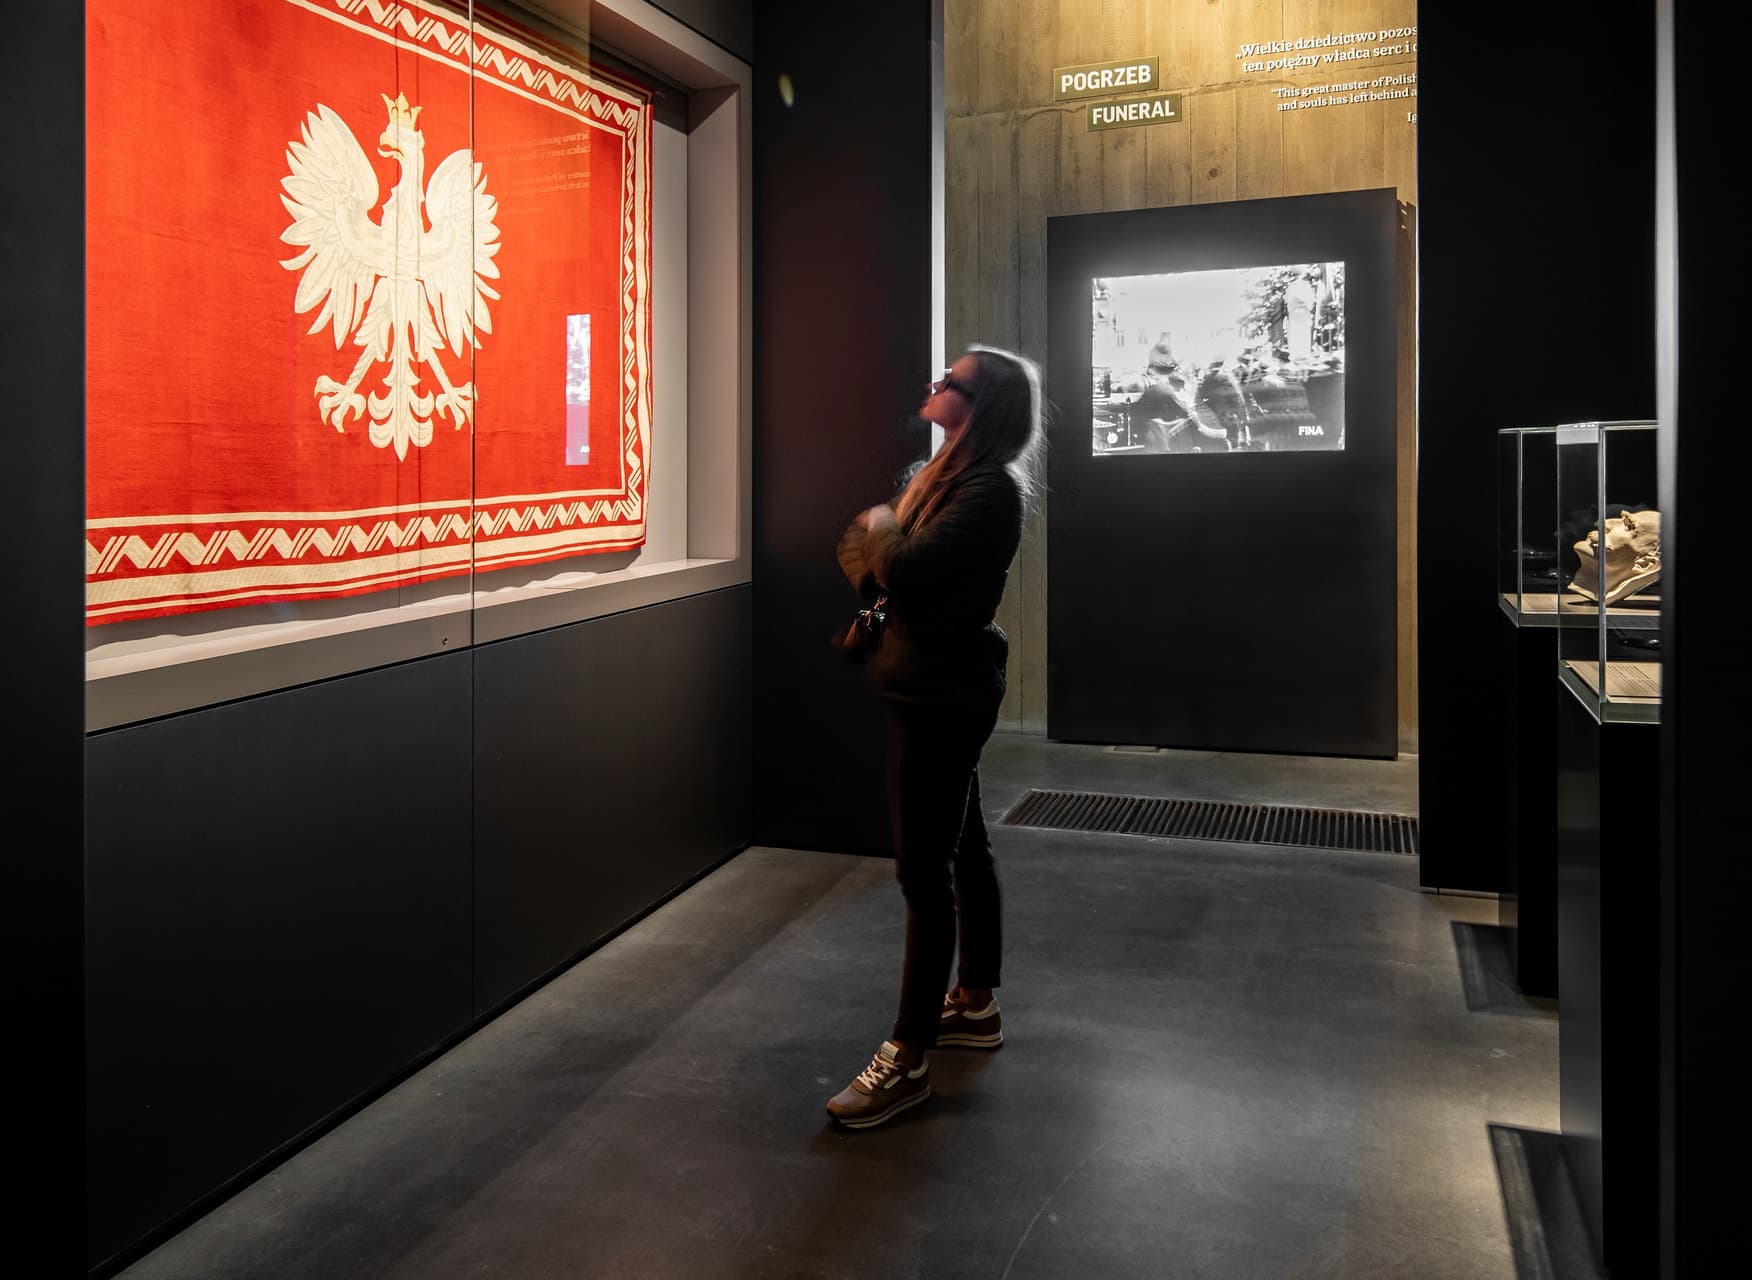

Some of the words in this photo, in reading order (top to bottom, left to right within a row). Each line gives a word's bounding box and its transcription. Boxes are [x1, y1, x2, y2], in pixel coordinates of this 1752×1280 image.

[1235, 40, 1293, 59] „Wielkie
[1295, 31, 1377, 50] dziedzictwo
[1242, 61, 1264, 73] ten
[1267, 54, 1321, 73] potężny
[1323, 47, 1371, 63] władca
[1373, 44, 1402, 57] serc
[1405, 41, 1411, 53] i
[1061, 64, 1152, 93] POGRZEB
[1302, 83, 1330, 97] great
[1332, 80, 1370, 93] master
[1371, 76, 1385, 88] of
[1092, 99, 1175, 125] FUNERAL
[1277, 99, 1298, 111] and
[1299, 97, 1328, 109] souls
[1329, 95, 1349, 106] has
[1350, 91, 1369, 103] left
[1370, 87, 1409, 101] behind
[1298, 425, 1325, 436] FINA
